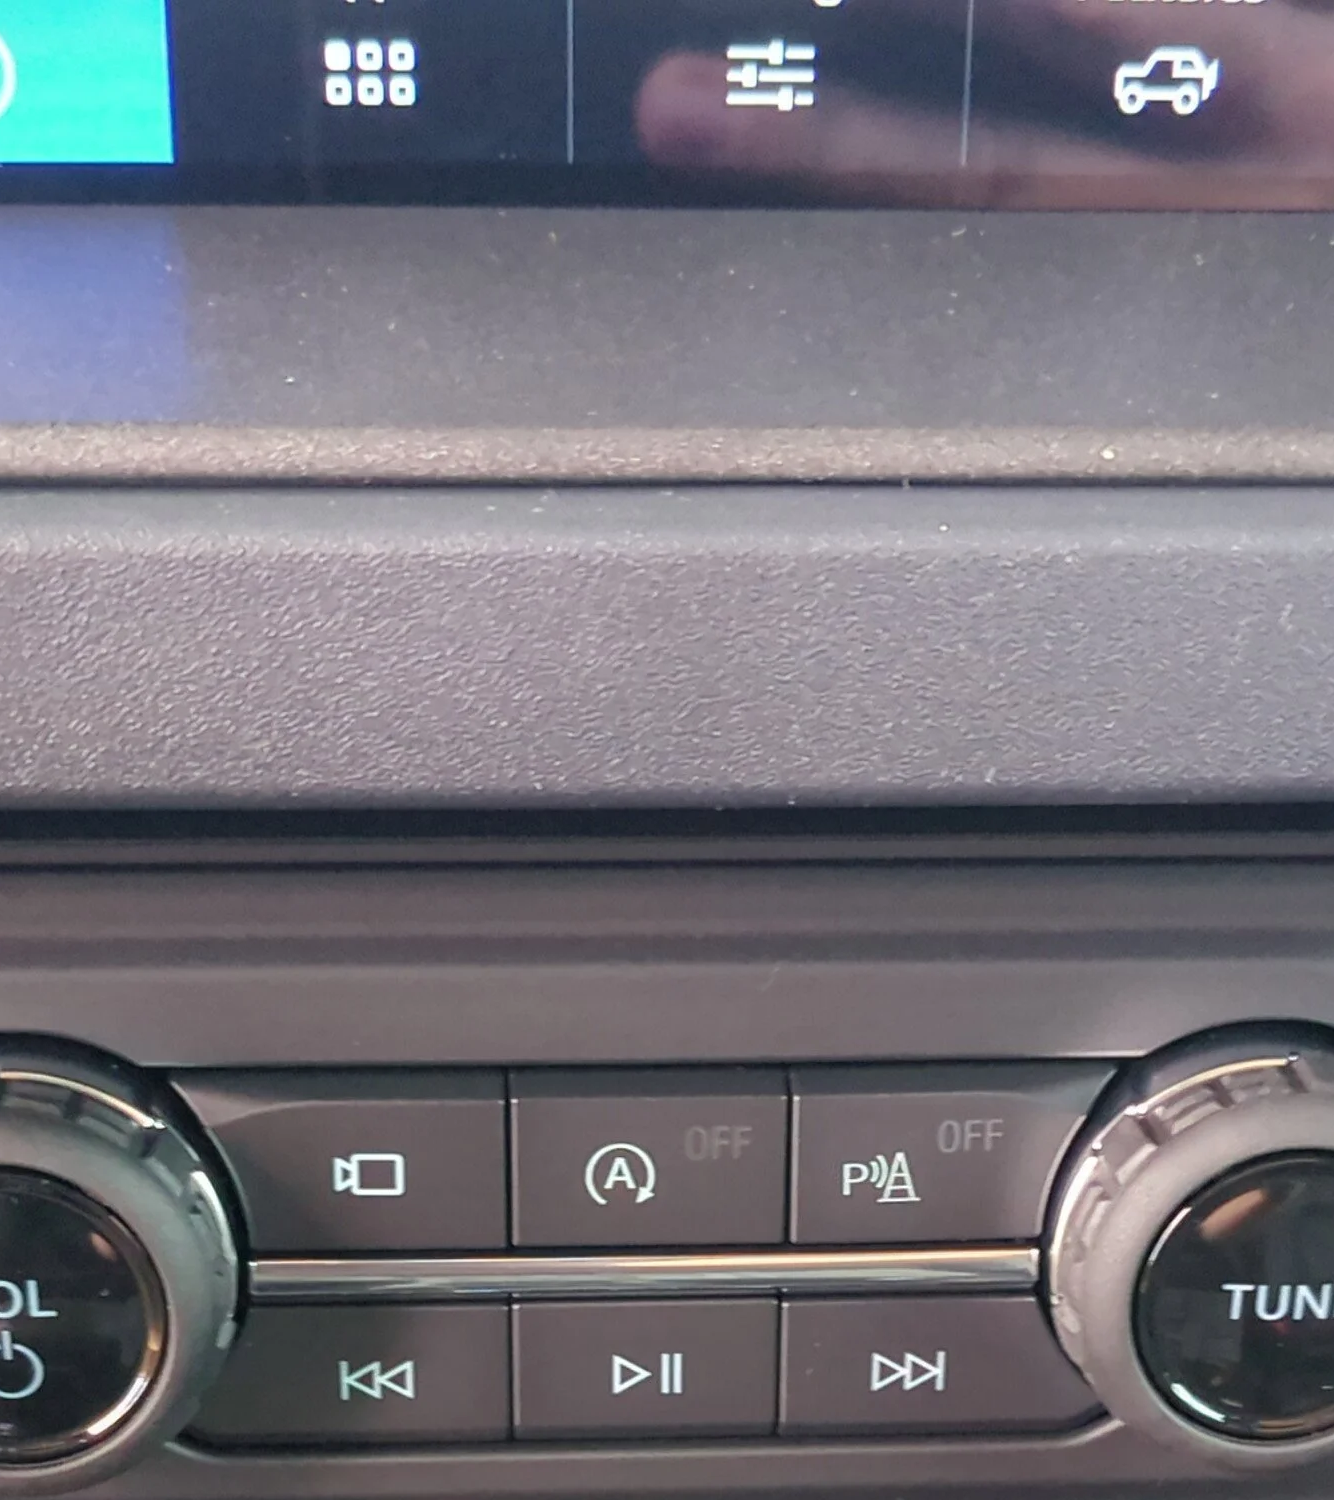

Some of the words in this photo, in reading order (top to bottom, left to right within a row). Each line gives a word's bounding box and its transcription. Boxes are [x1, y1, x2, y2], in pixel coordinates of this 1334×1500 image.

[683, 1124, 754, 1162] OFF
[936, 1117, 1005, 1154] OFF
[841, 1162, 867, 1197] P
